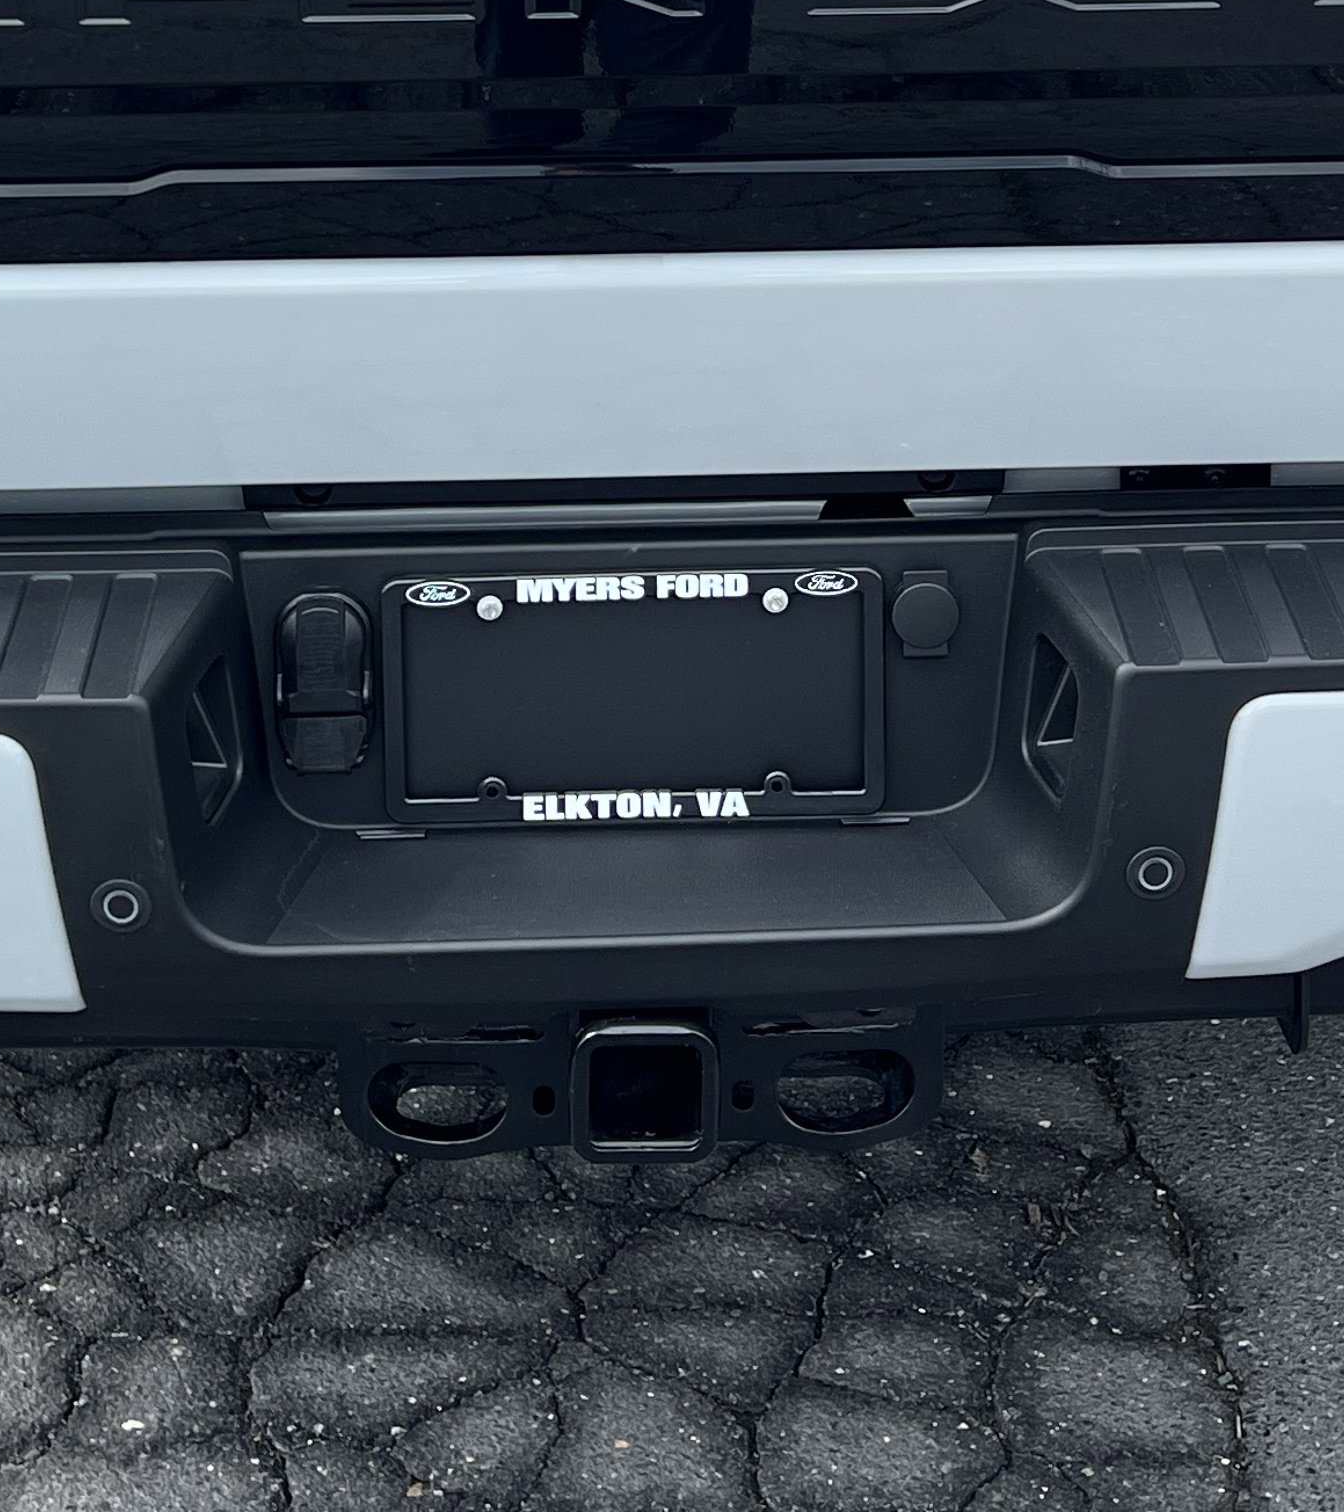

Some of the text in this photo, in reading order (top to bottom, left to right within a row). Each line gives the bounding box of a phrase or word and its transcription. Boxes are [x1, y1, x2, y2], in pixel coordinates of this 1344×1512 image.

[419, 584, 457, 601] Ford
[515, 572, 750, 604] MYERS FORD
[807, 574, 845, 590] Ford
[521, 789, 751, 821] ELKTON, VA
